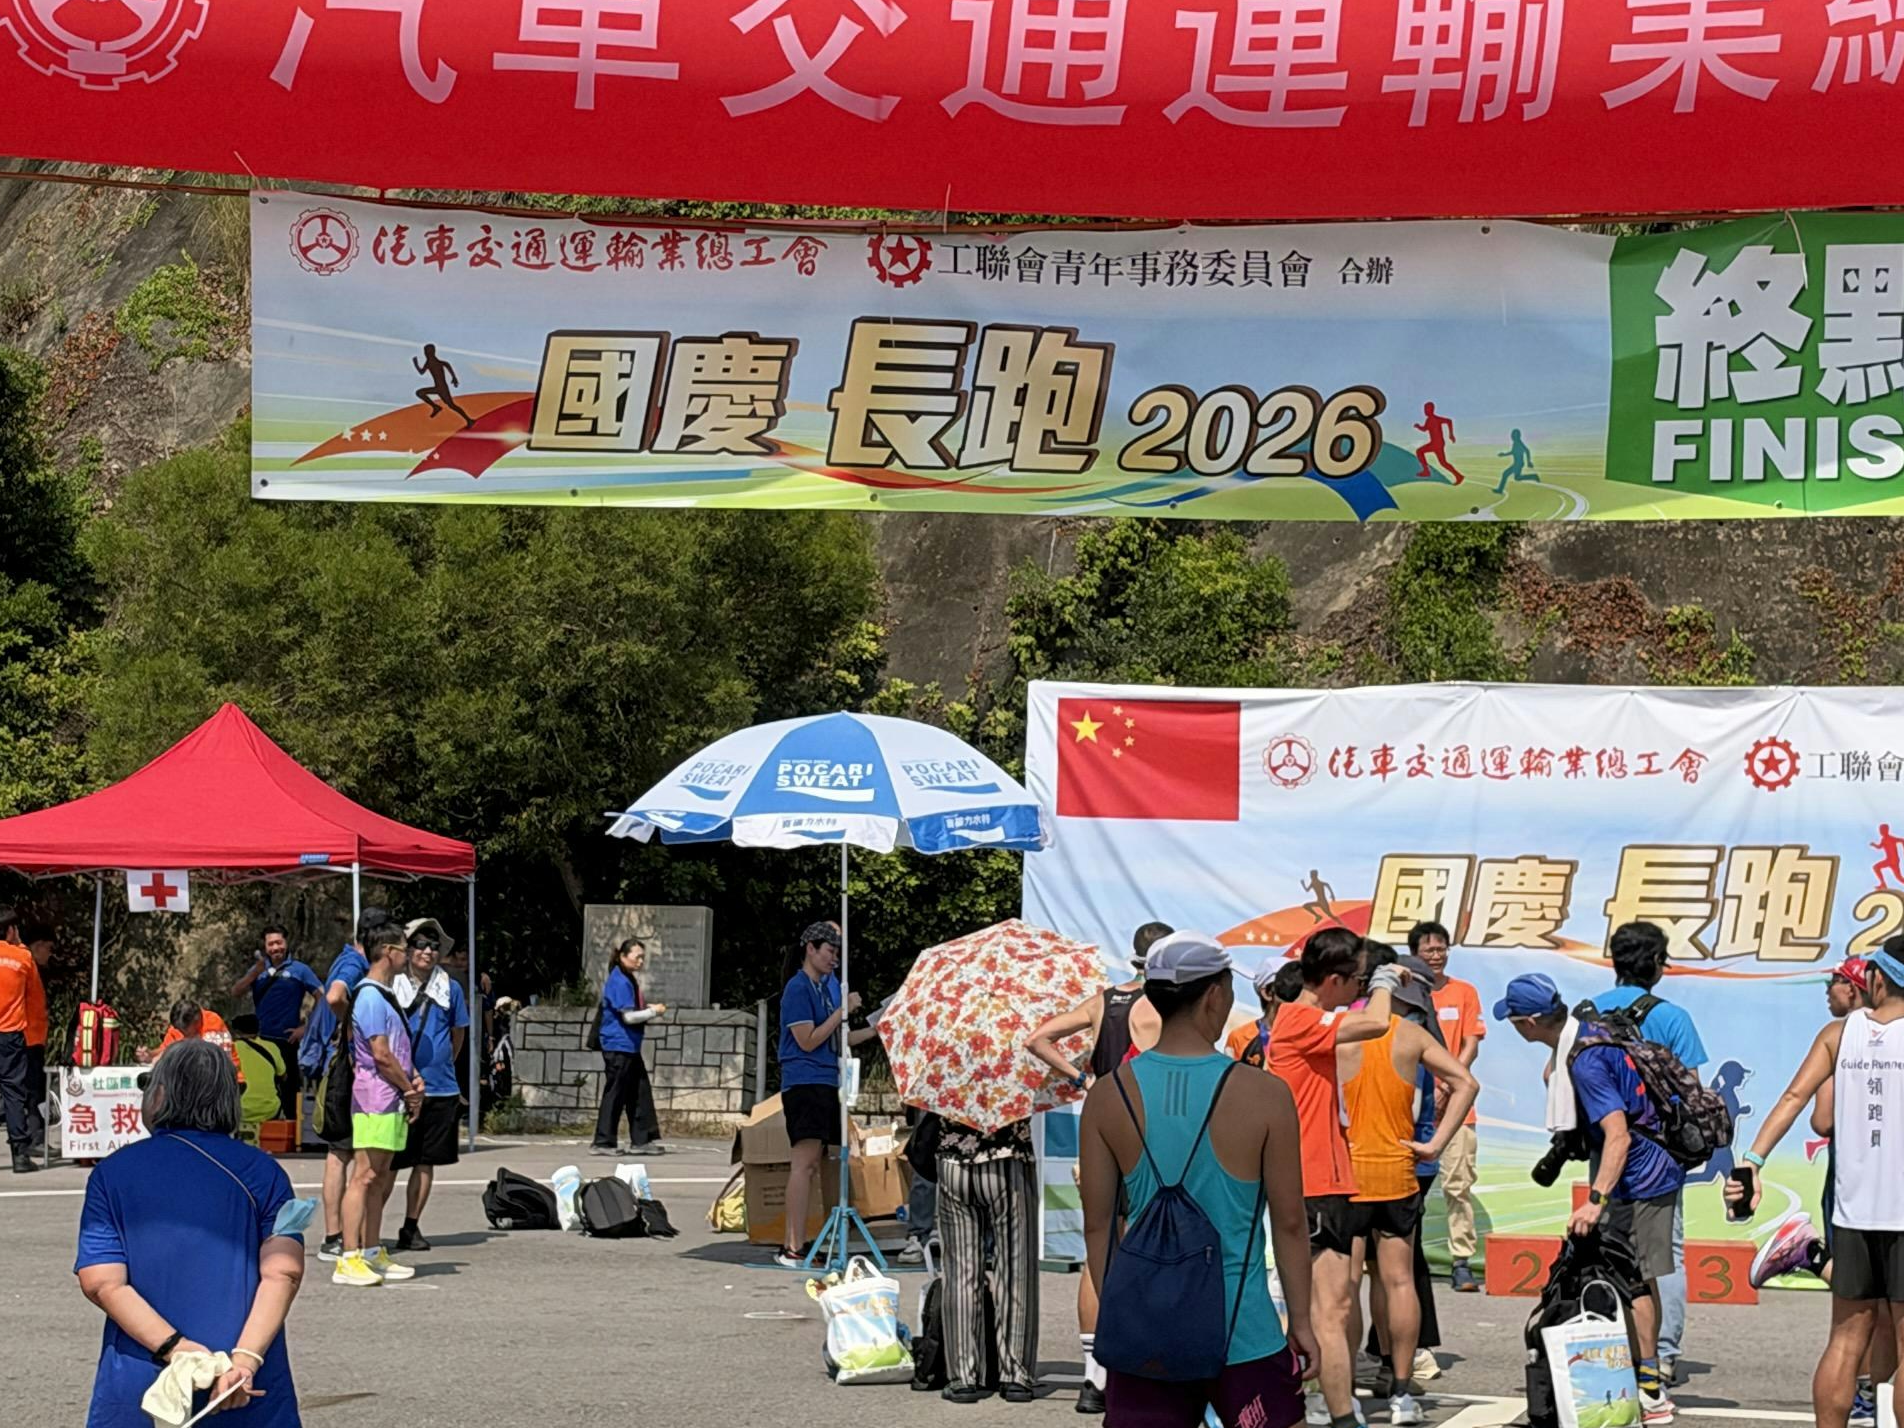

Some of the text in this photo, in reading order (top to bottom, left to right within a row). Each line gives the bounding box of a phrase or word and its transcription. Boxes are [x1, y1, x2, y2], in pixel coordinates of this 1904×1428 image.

[372, 225, 1394, 288] 汽車交通運輸業總工會 工聯會青年事務委員會 合辦
[526, 316, 1385, 478] 國慶 長跑 2026
[691, 762, 752, 775] POCARI
[778, 763, 873, 776] POCARI
[902, 759, 981, 775] POCARI
[1327, 744, 1710, 784] 汽車交通運輸業總工會
[680, 773, 736, 786] SWEAT
[777, 774, 863, 787] SWEAT
[910, 771, 979, 786] SWEAT
[1368, 853, 1578, 949] 國慶
[1603, 844, 1839, 962] 長跑
[1841, 1058, 1869, 1070] Guide
[68, 1103, 142, 1134] 急救
[1867, 1077, 1883, 1148] 領跑員
[70, 1140, 100, 1151] First
[1511, 1251, 1543, 1294] 2
[1698, 1255, 1734, 1300] 3
